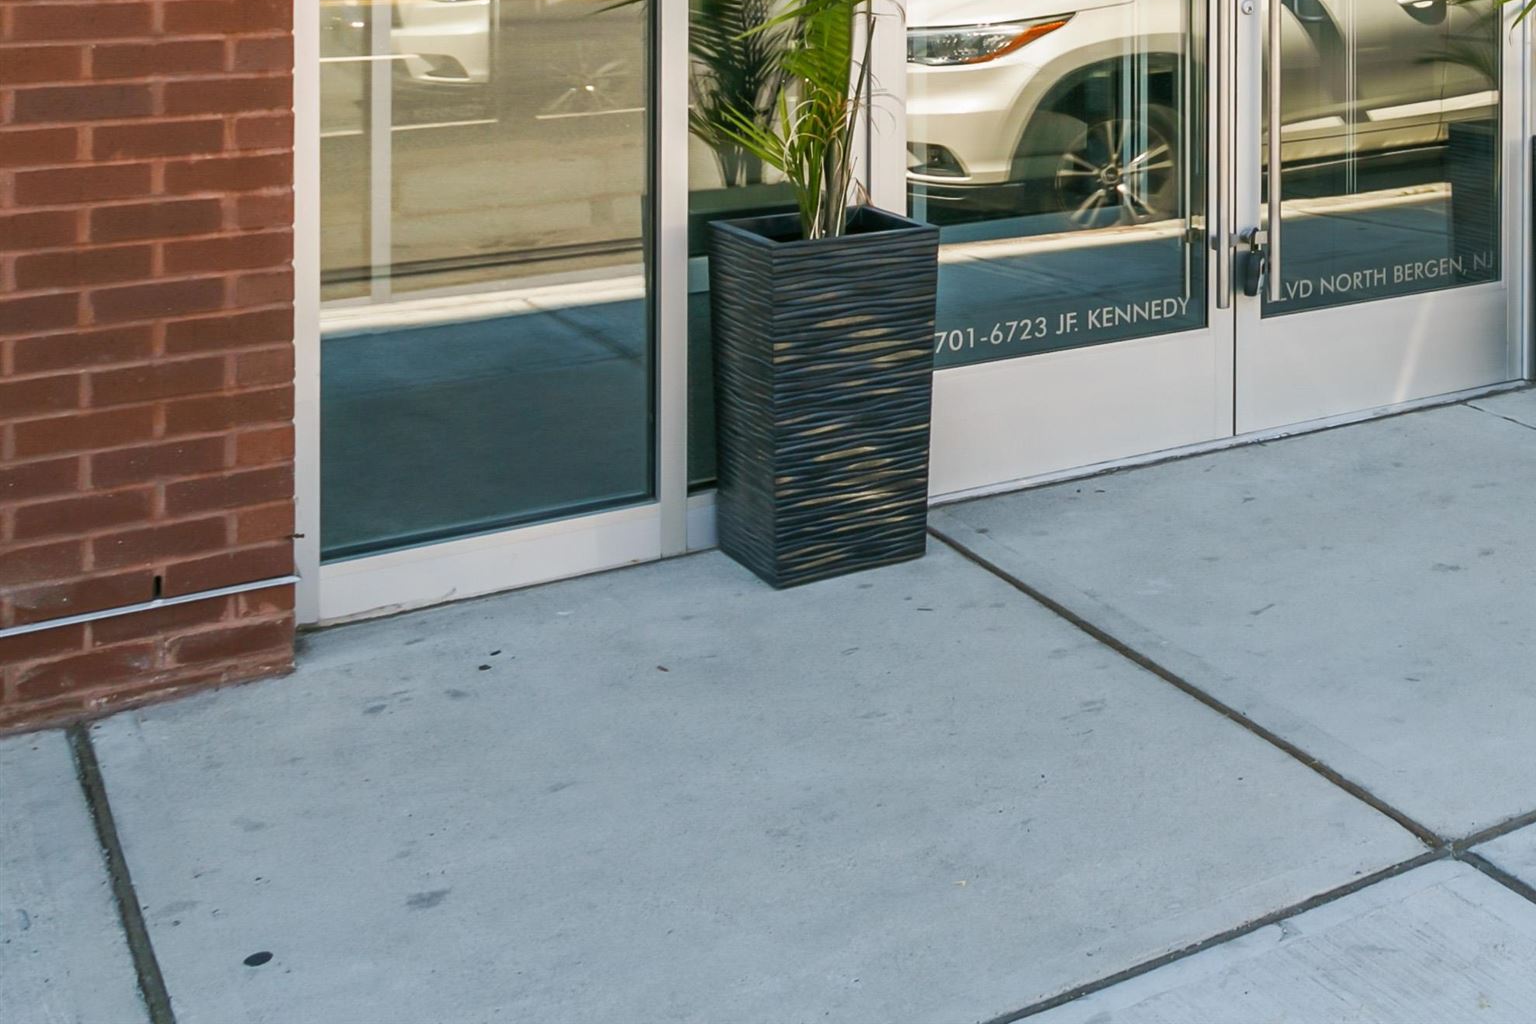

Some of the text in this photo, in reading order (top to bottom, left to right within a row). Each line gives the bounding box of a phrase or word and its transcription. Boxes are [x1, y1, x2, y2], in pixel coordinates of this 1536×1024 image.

[1320, 267, 1386, 295] NORTH
[1393, 256, 1468, 283] BERGEN,
[1473, 251, 1493, 270] NJ
[1088, 296, 1191, 330] KENNEDY
